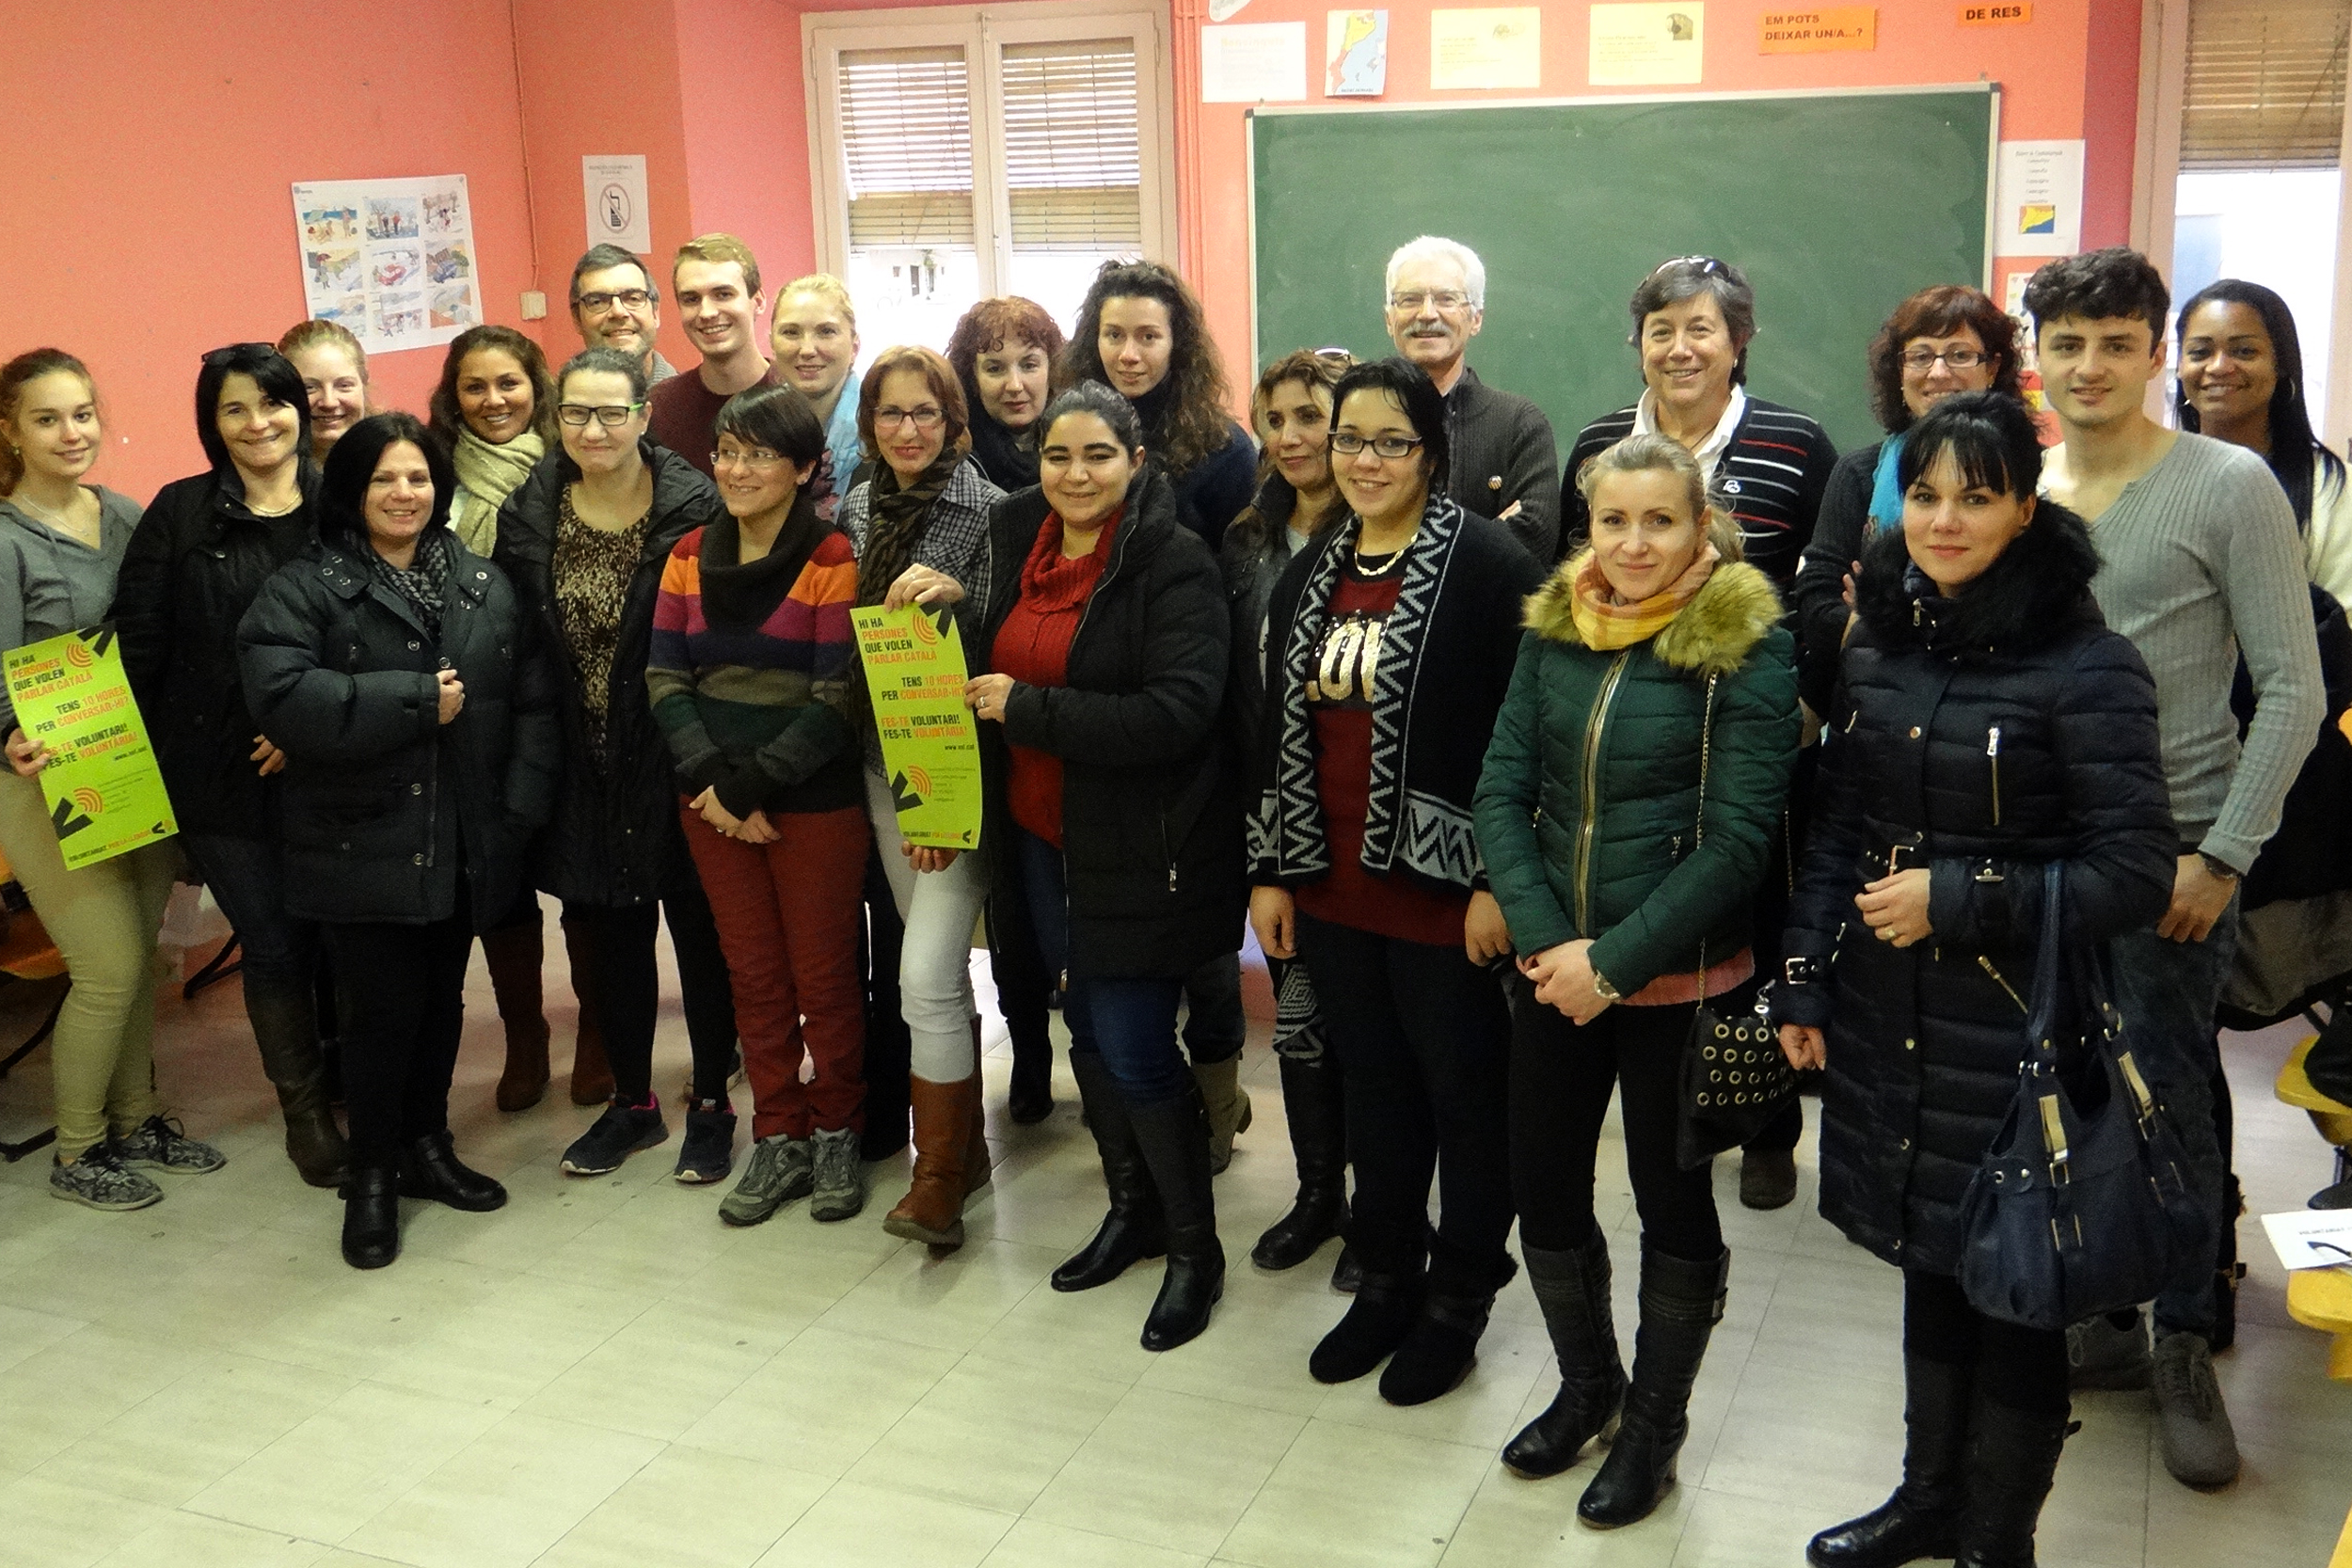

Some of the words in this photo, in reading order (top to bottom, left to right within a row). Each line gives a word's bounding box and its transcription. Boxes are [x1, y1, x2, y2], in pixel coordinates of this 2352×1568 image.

[1765, 16, 1784, 25] EM
[1787, 14, 1820, 24] POTS
[1965, 8, 1986, 21] DE
[1991, 6, 2022, 19] RES
[1764, 29, 1811, 41] DEIXAR
[858, 618, 868, 629] HI
[870, 617, 883, 627] HA
[862, 626, 908, 641] PERSONES
[865, 641, 882, 654] QUE
[884, 640, 914, 651] VOLEN
[8, 658, 20, 670] HI
[22, 655, 36, 666] HA
[867, 653, 902, 665] PARLAR
[11, 657, 61, 679] PERSONES
[13, 677, 34, 692] QUE
[34, 667, 66, 685] VOLEN
[901, 675, 923, 688] TENS
[925, 675, 935, 686] 10
[937, 673, 964, 685] HORES
[17, 686, 56, 704] PARLAR
[55, 699, 81, 715] TENS
[82, 696, 95, 708] 10
[95, 685, 127, 703] HORES
[882, 690, 899, 702] PER
[36, 720, 56, 735] PER
[56, 696, 129, 728] CONVERSAR-HI?
[881, 716, 910, 728] FES-TE
[910, 714, 961, 726] VOLUNTARI!
[73, 722, 129, 748] VOLUNTARI!
[883, 728, 913, 740] FES-TE
